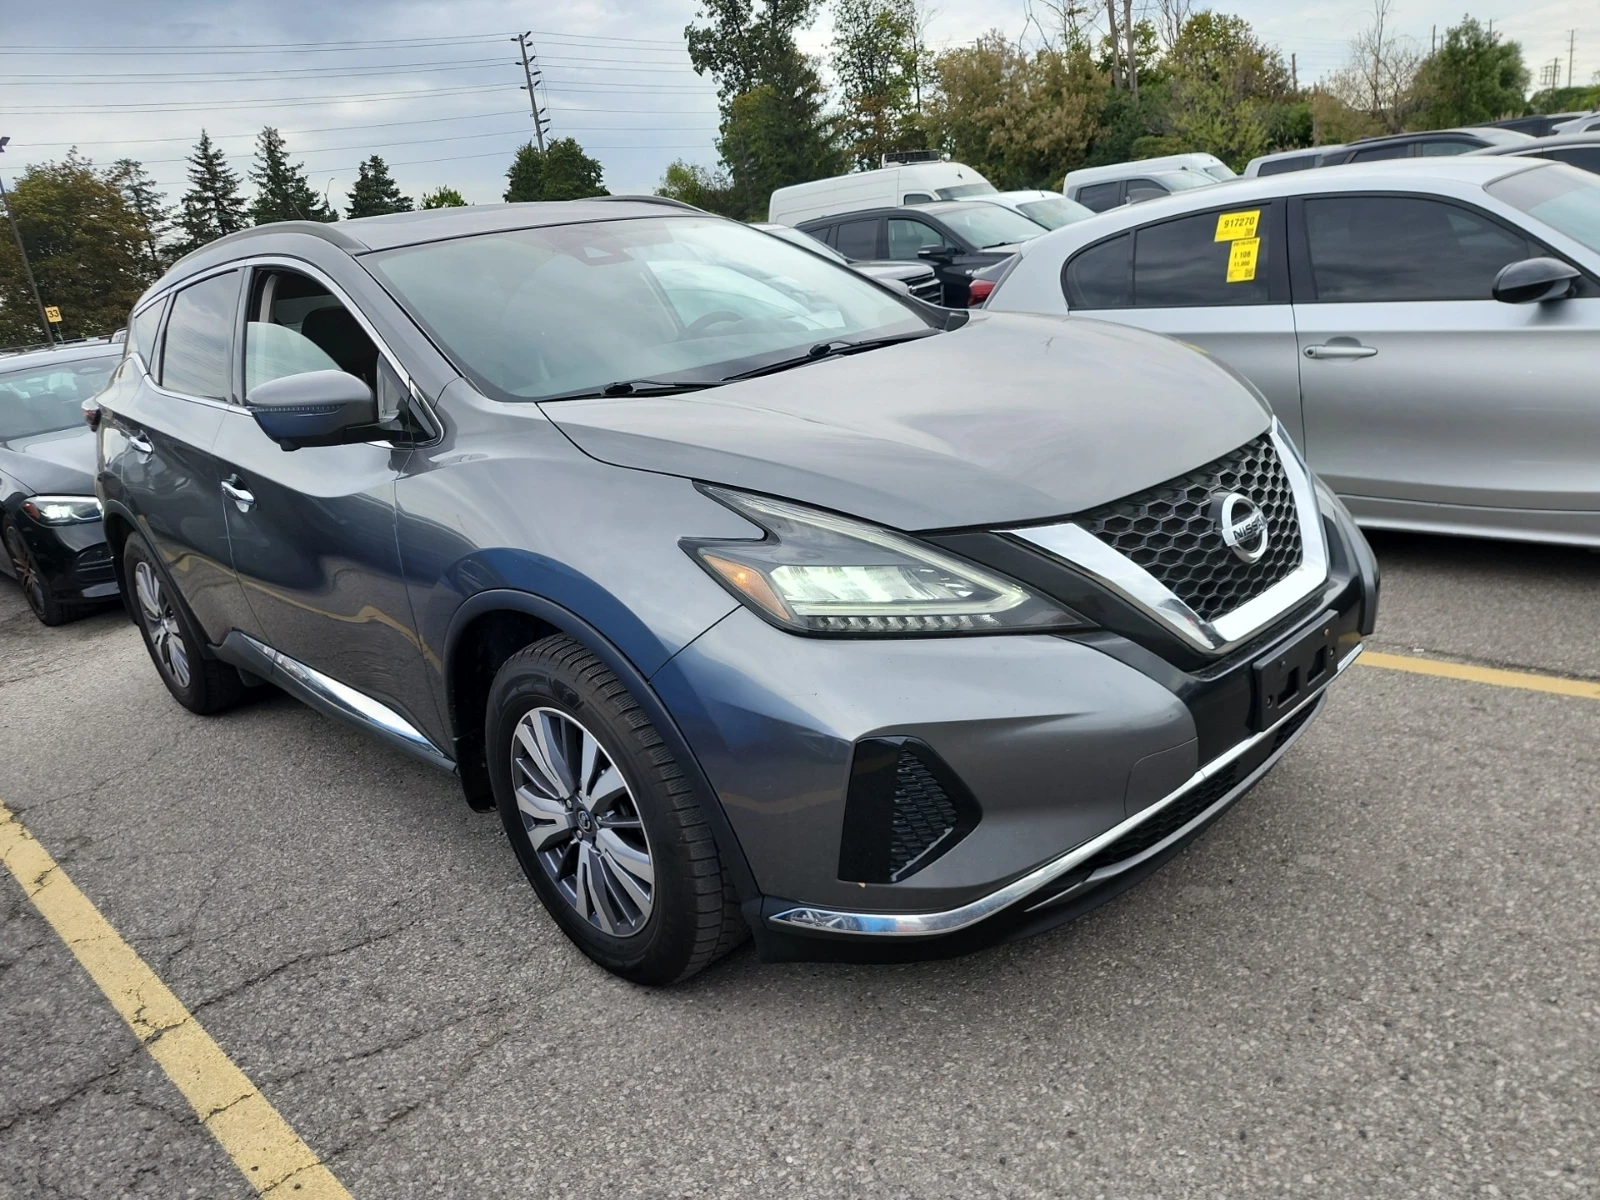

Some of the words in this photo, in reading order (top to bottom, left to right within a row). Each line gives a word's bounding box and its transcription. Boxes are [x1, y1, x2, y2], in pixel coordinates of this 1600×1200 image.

[1224, 217, 1255, 228] 917270
[47, 309, 59, 318] 33
[1233, 515, 1267, 540] NISSAN
